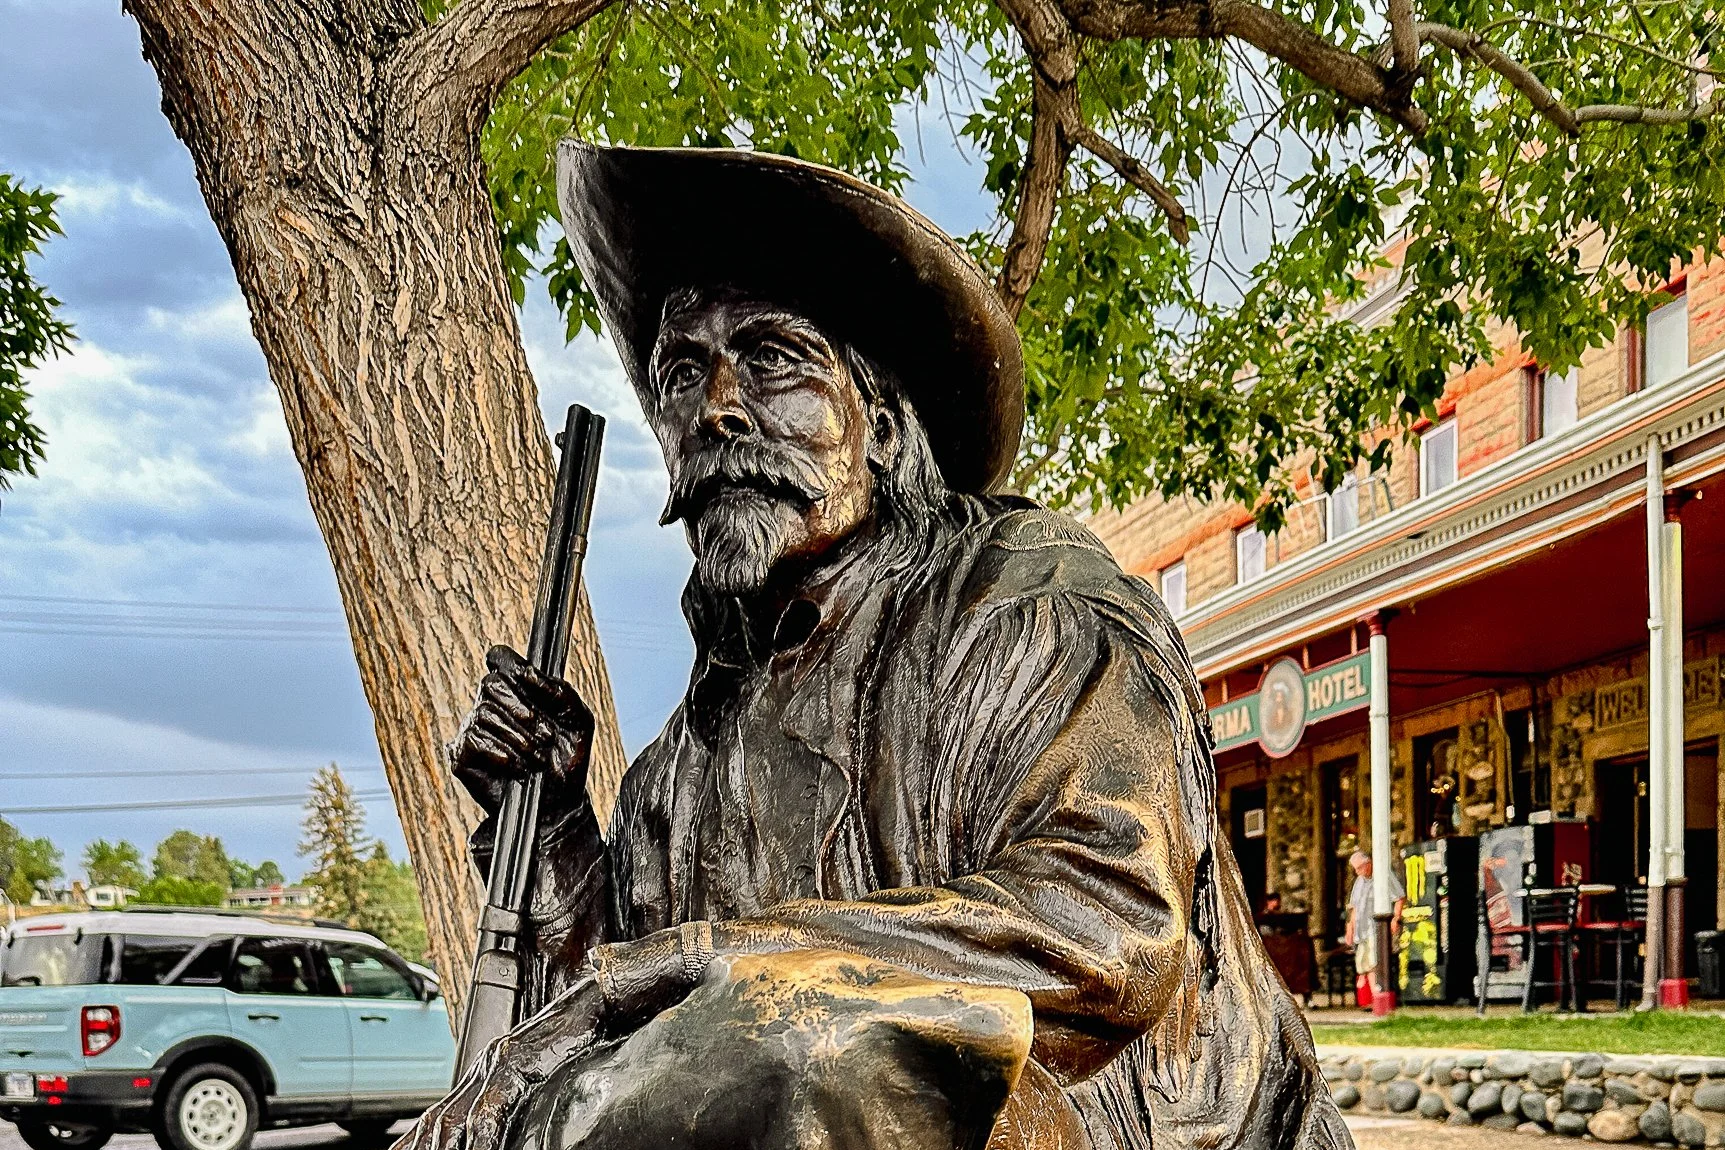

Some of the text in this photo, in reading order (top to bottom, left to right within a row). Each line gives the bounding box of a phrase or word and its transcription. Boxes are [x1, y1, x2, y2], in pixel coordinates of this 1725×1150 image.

[1213, 664, 1367, 741] RMA HOTEL
[1598, 664, 1716, 728] WELME
